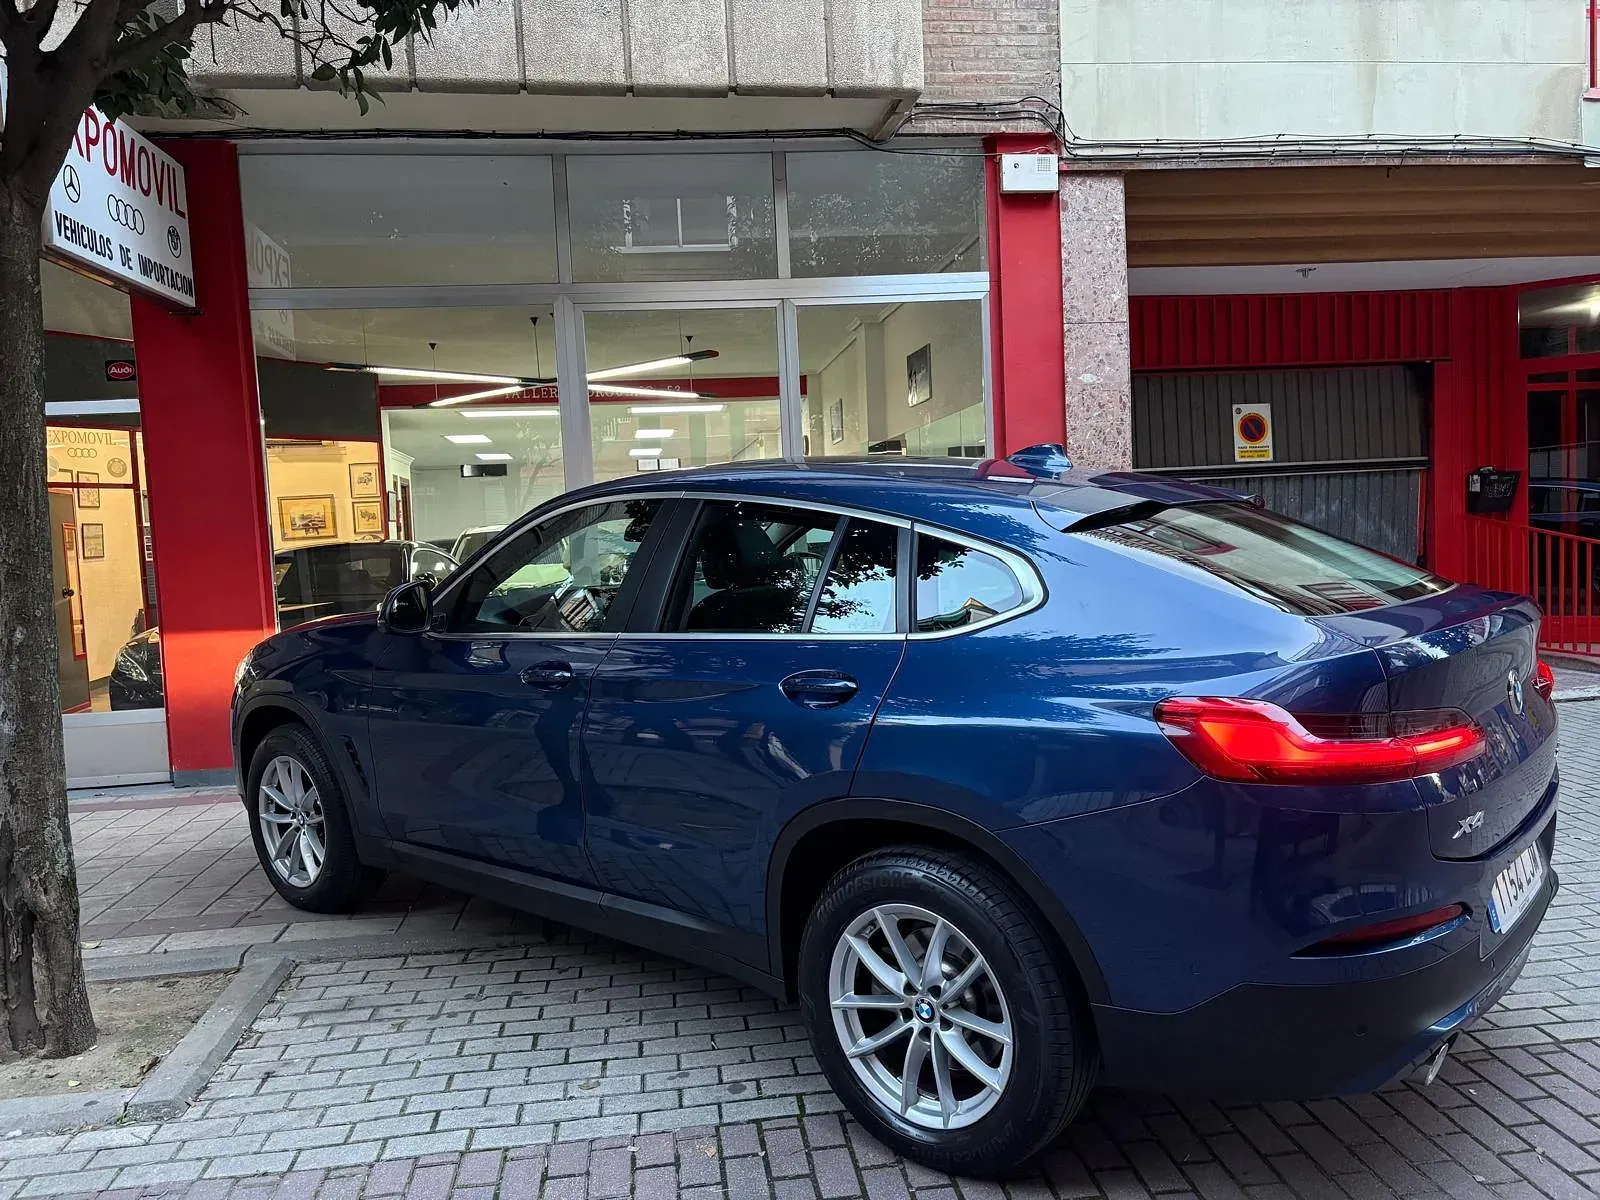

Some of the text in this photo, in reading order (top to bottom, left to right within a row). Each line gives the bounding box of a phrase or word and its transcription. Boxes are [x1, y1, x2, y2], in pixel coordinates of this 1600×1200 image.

[54, 210, 114, 262] VEHICULOS
[119, 243, 134, 271] DE
[138, 253, 194, 299] IMPORTACION
[110, 366, 132, 374] Audi
[1452, 810, 1485, 839] X4
